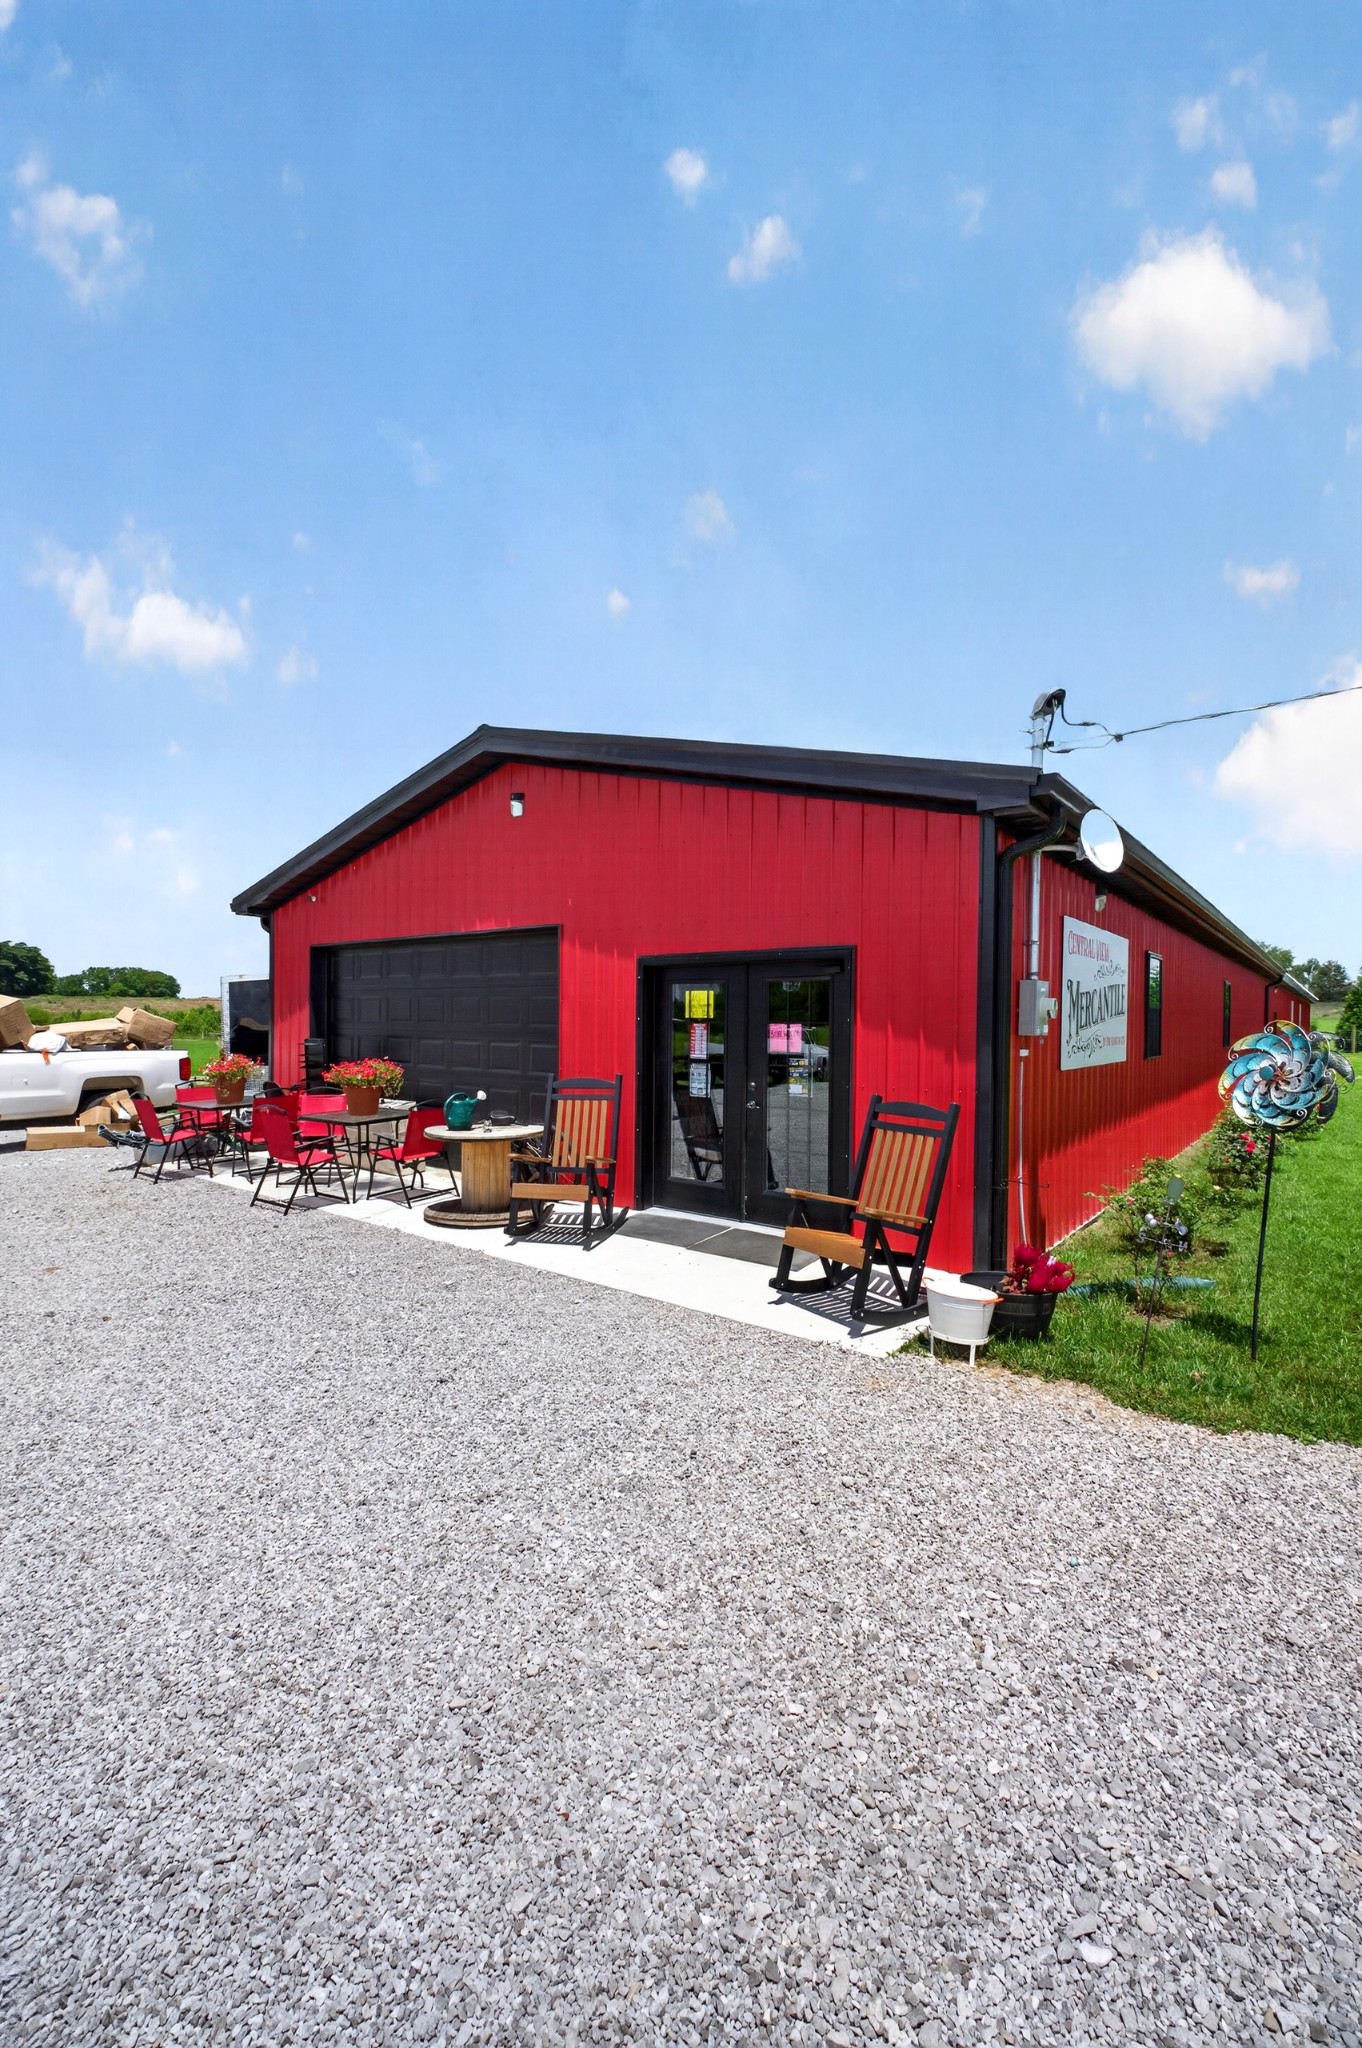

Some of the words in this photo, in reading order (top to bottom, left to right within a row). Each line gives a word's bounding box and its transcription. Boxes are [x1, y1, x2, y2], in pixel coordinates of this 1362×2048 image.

[1068, 930, 1095, 959] CENTRAL
[1096, 938, 1110, 962] VIEW
[1067, 978, 1125, 1037] MERCANTILE
